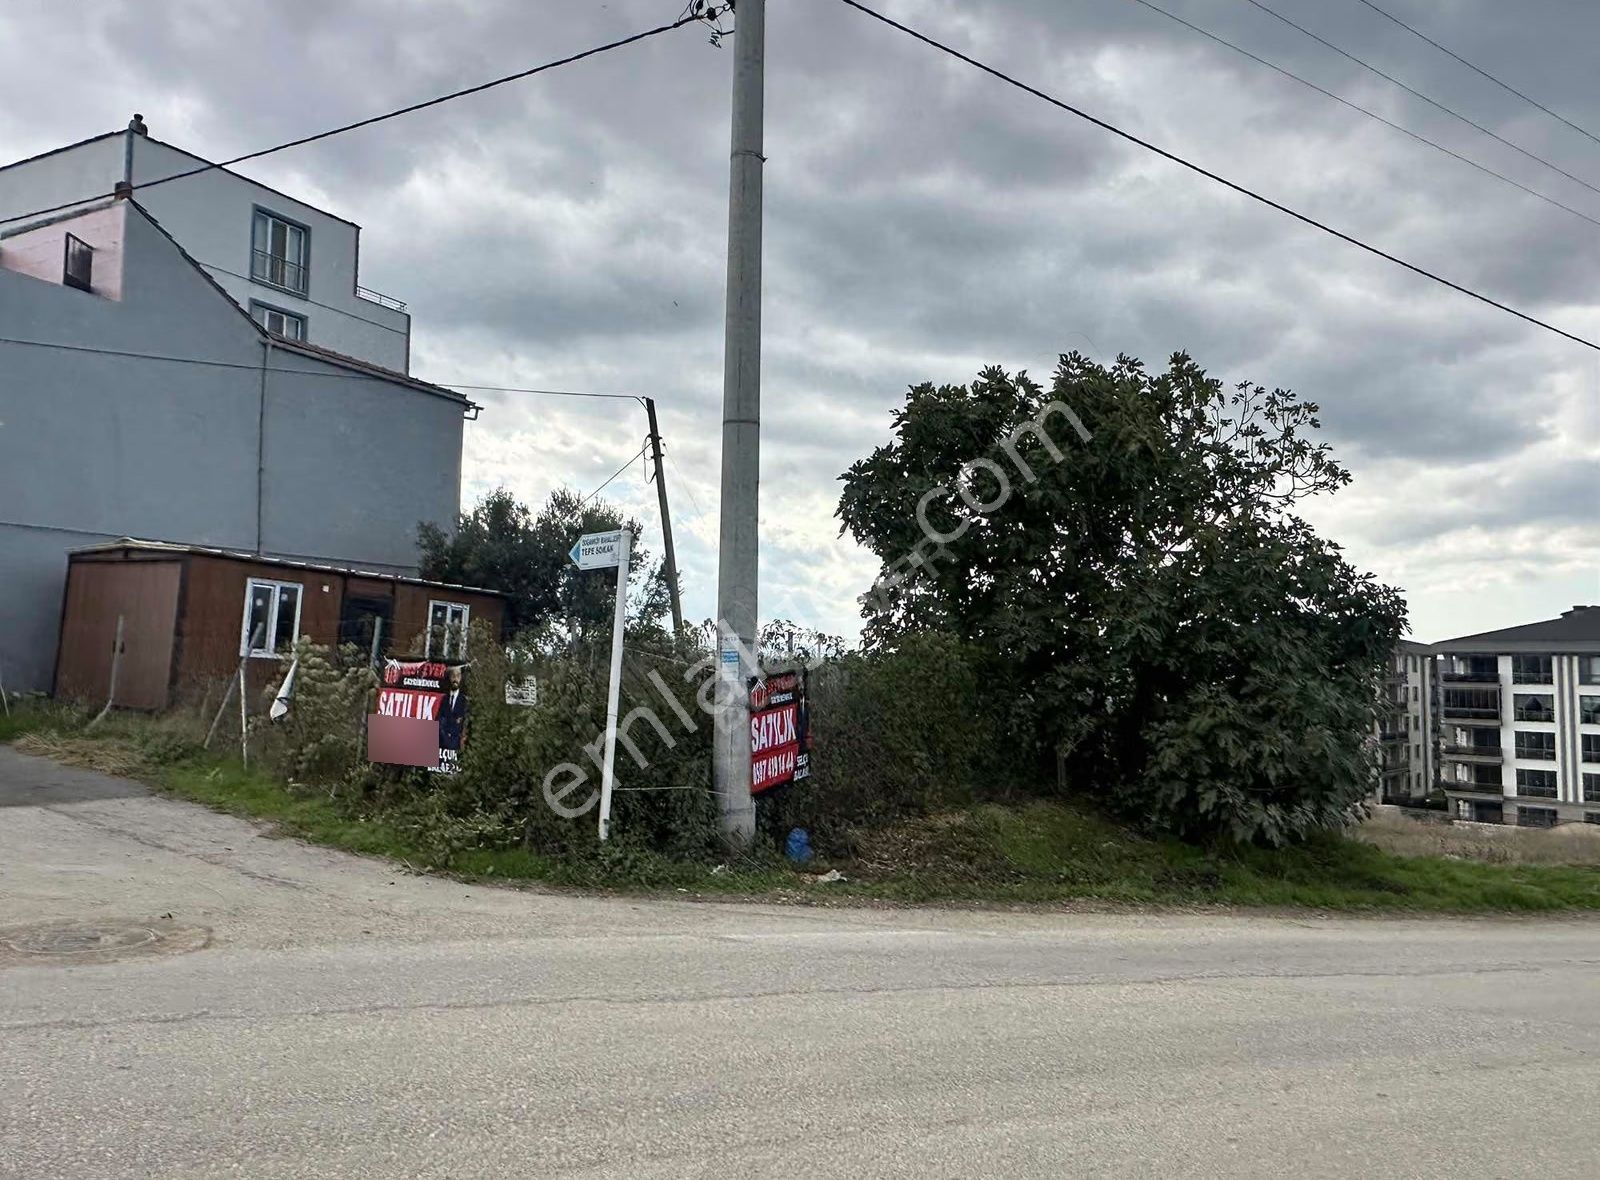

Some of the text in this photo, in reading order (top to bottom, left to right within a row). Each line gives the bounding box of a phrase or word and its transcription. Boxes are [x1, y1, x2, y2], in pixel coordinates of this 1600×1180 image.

[582, 544, 614, 556] TEPE SOKAK
[378, 691, 436, 720] SATILIK
[751, 708, 797, 752] SATILIK
